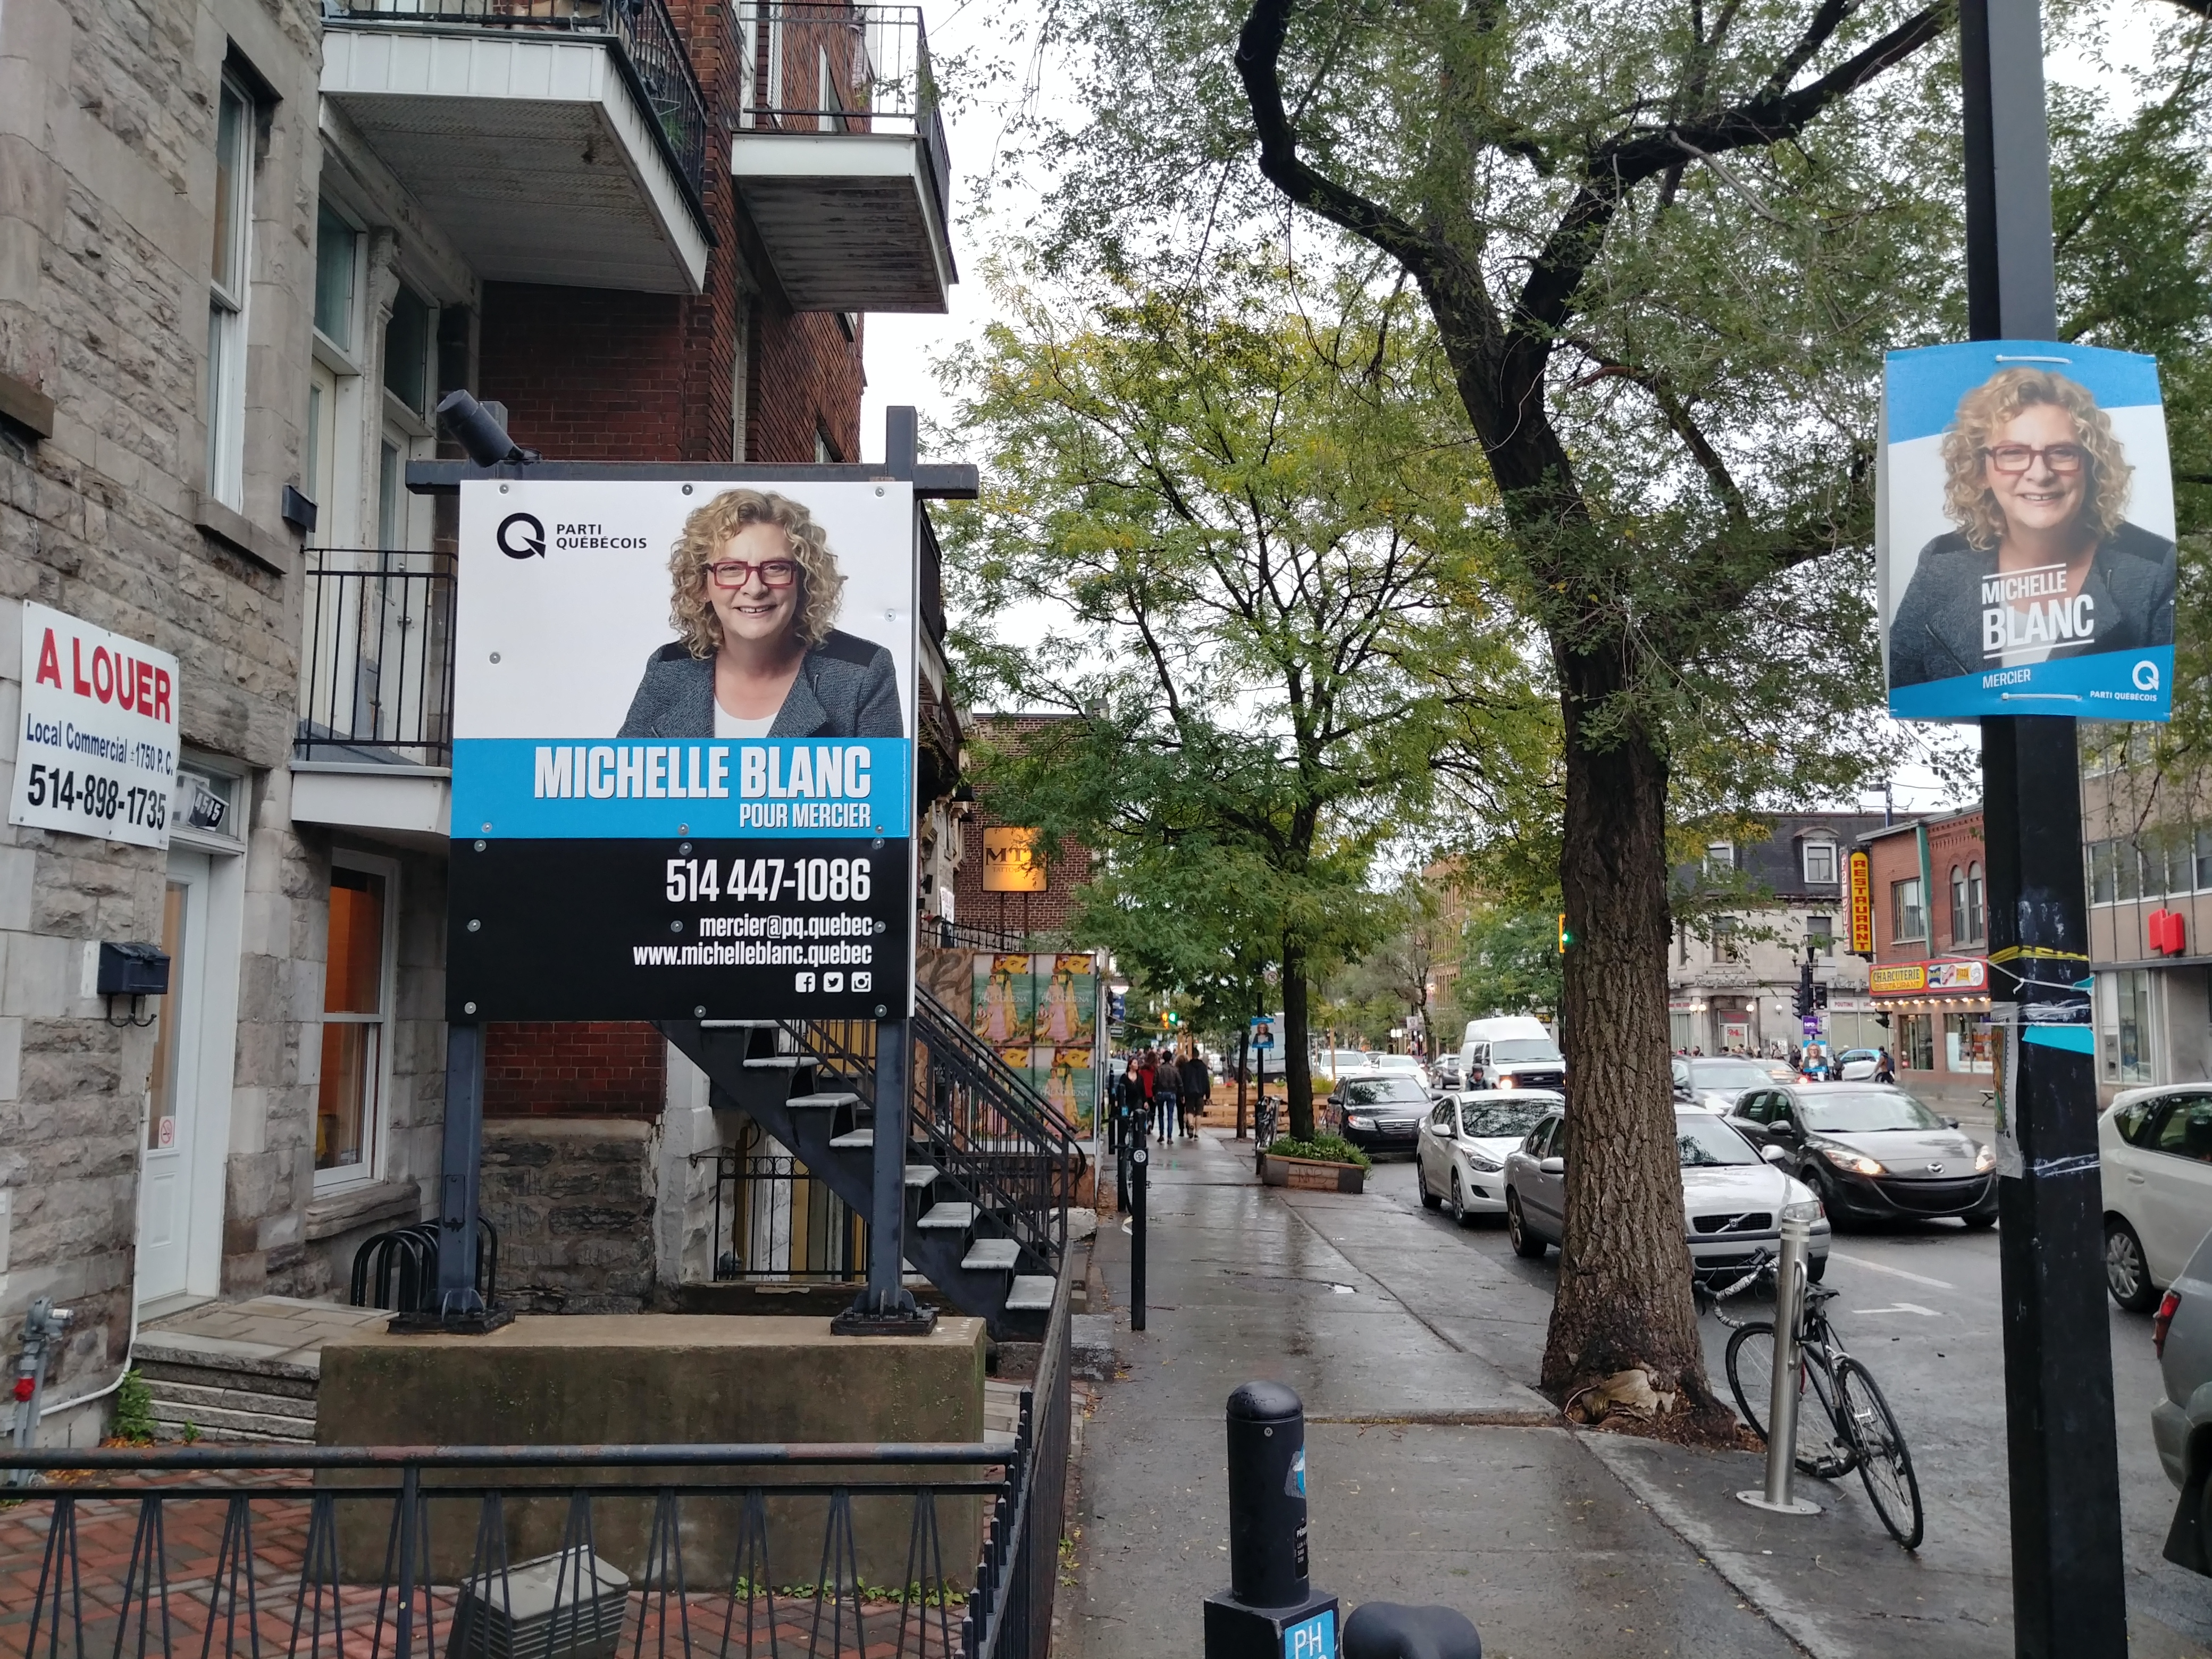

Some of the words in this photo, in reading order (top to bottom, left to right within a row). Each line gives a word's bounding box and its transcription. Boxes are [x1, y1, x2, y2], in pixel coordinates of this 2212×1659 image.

[556, 524, 602, 535] PARTI
[556, 534, 648, 550] QUÉBÉCOIS
[1982, 570, 2067, 605] MICHELLE
[1982, 594, 2094, 652] BLANC
[36, 627, 62, 690] A
[73, 636, 171, 724] LOUER
[1982, 669, 2031, 689] MERCIER
[26, 713, 62, 748] Local
[66, 723, 127, 764] Commercial
[534, 745, 730, 800] MICHELLE
[740, 745, 871, 799] BLANC
[28, 763, 166, 831] 514-898-1735
[740, 803, 789, 828] POUR
[792, 803, 871, 828] MERCIER
[666, 859, 719, 902] 514
[727, 859, 870, 902] 447-1086
[1854, 860, 1869, 950] RESTAURANT
[700, 913, 873, 941] mercier@pq.quebec
[633, 942, 872, 967] www.michelleblanc.quebec
[1873, 966, 1920, 983] CHARCUTERIE
[1875, 981, 1920, 991] RESTAURANT
[1295, 1621, 1322, 1659] PH
